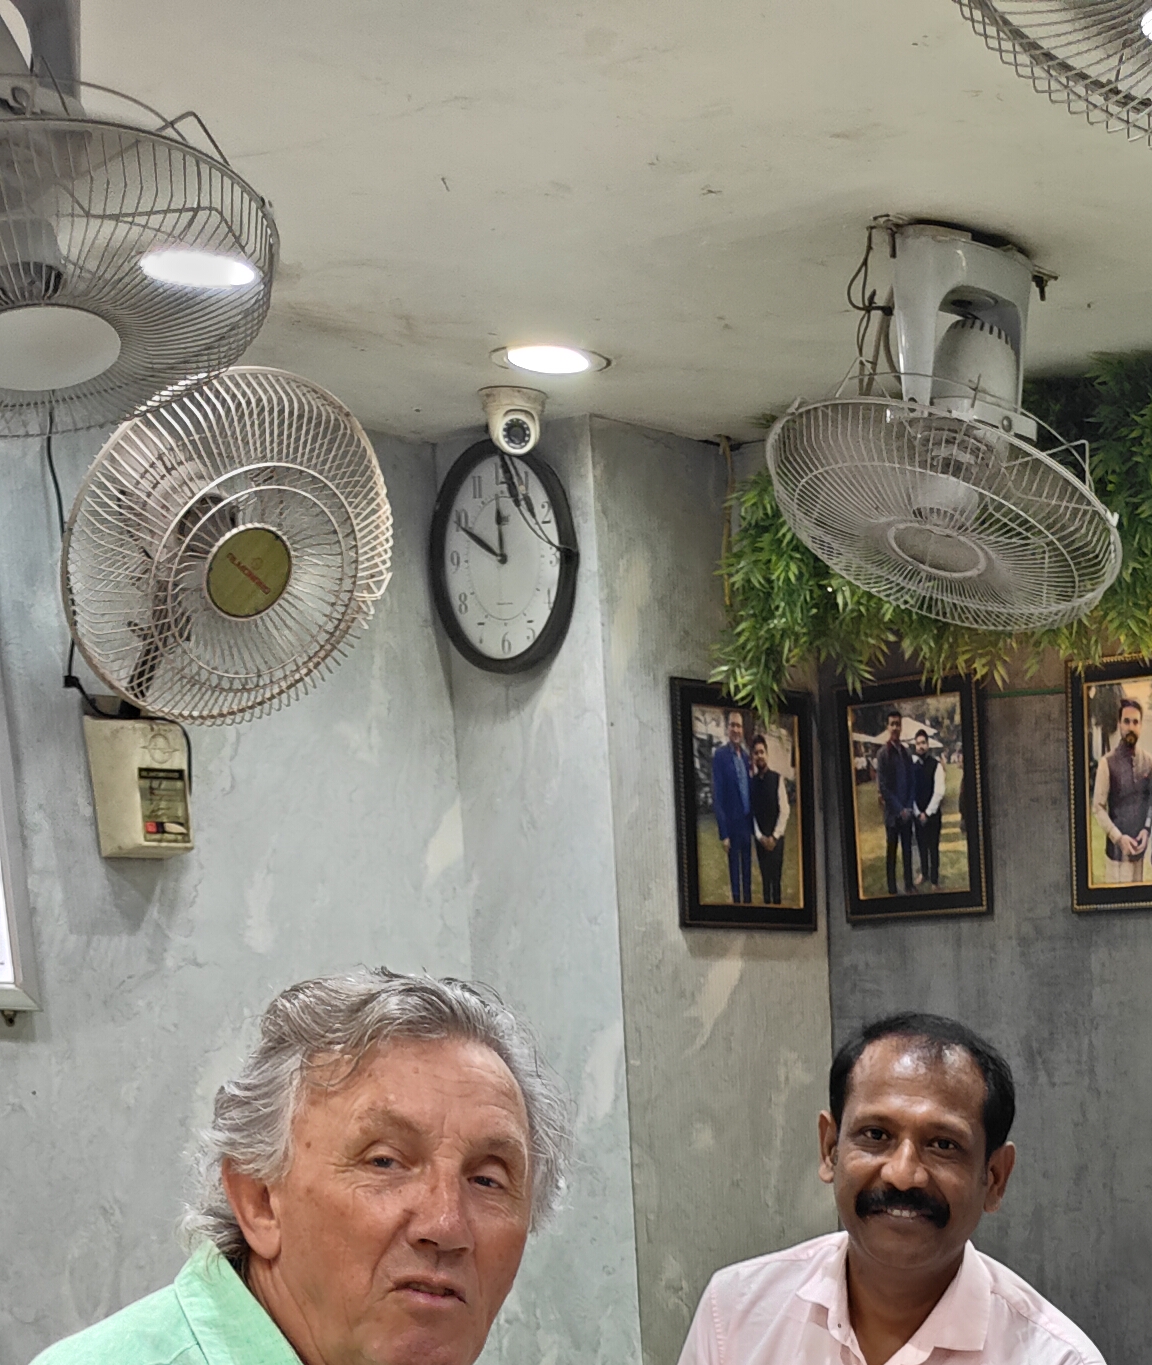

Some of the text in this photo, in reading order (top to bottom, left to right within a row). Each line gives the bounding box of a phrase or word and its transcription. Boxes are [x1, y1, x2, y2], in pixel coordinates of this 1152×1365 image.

[472, 475, 483, 499] 11
[455, 508, 469, 532] 10
[541, 500, 552, 524] 2
[450, 550, 461, 574] 9
[458, 591, 468, 615] 8
[501, 632, 512, 655] 6
